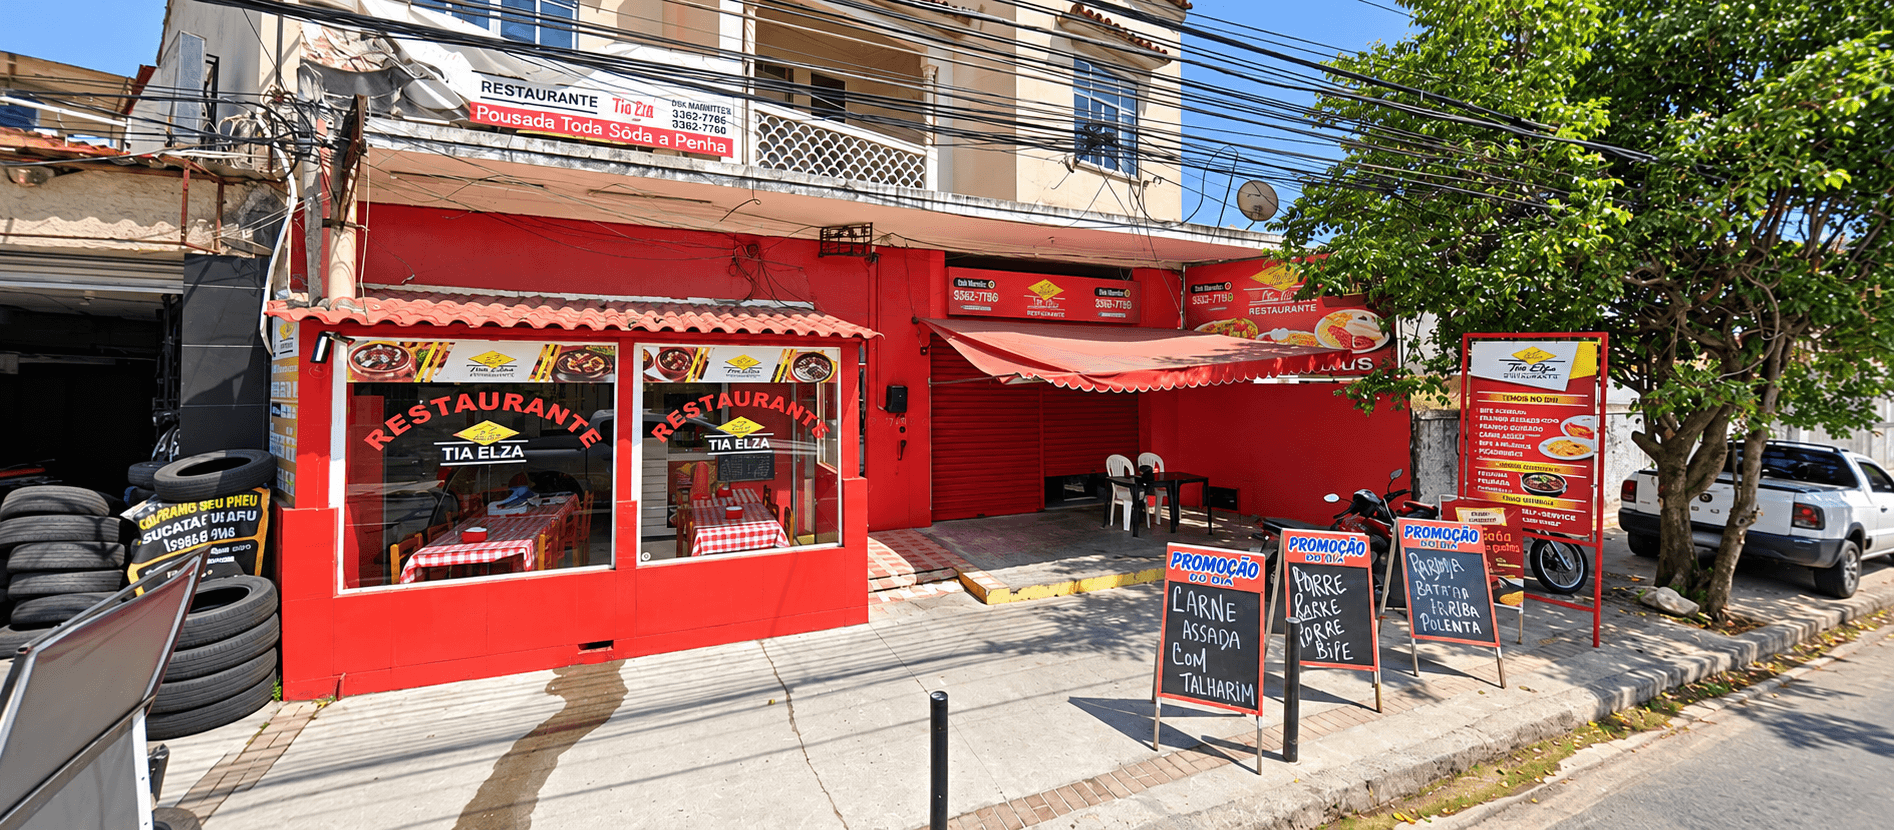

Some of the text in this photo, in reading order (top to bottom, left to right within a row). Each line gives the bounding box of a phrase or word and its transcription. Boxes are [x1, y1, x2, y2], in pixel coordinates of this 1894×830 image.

[481, 80, 598, 108] RESTAURANTE
[476, 105, 727, 153] Pousada Toda Sôda a Penha
[1248, 304, 1317, 315] RESTAURANTE
[363, 391, 603, 451] RESTAURANTE
[442, 445, 525, 461] TIA ELZA
[708, 437, 770, 451] TIA ELZA
[1404, 525, 1479, 544] PROMOÇÃO
[1289, 536, 1366, 556] PROMOÇÃO
[1170, 551, 1260, 579] PROMOÇÃO
[1420, 613, 1482, 634] POLENTA
[1183, 620, 1240, 650] ASSADA
